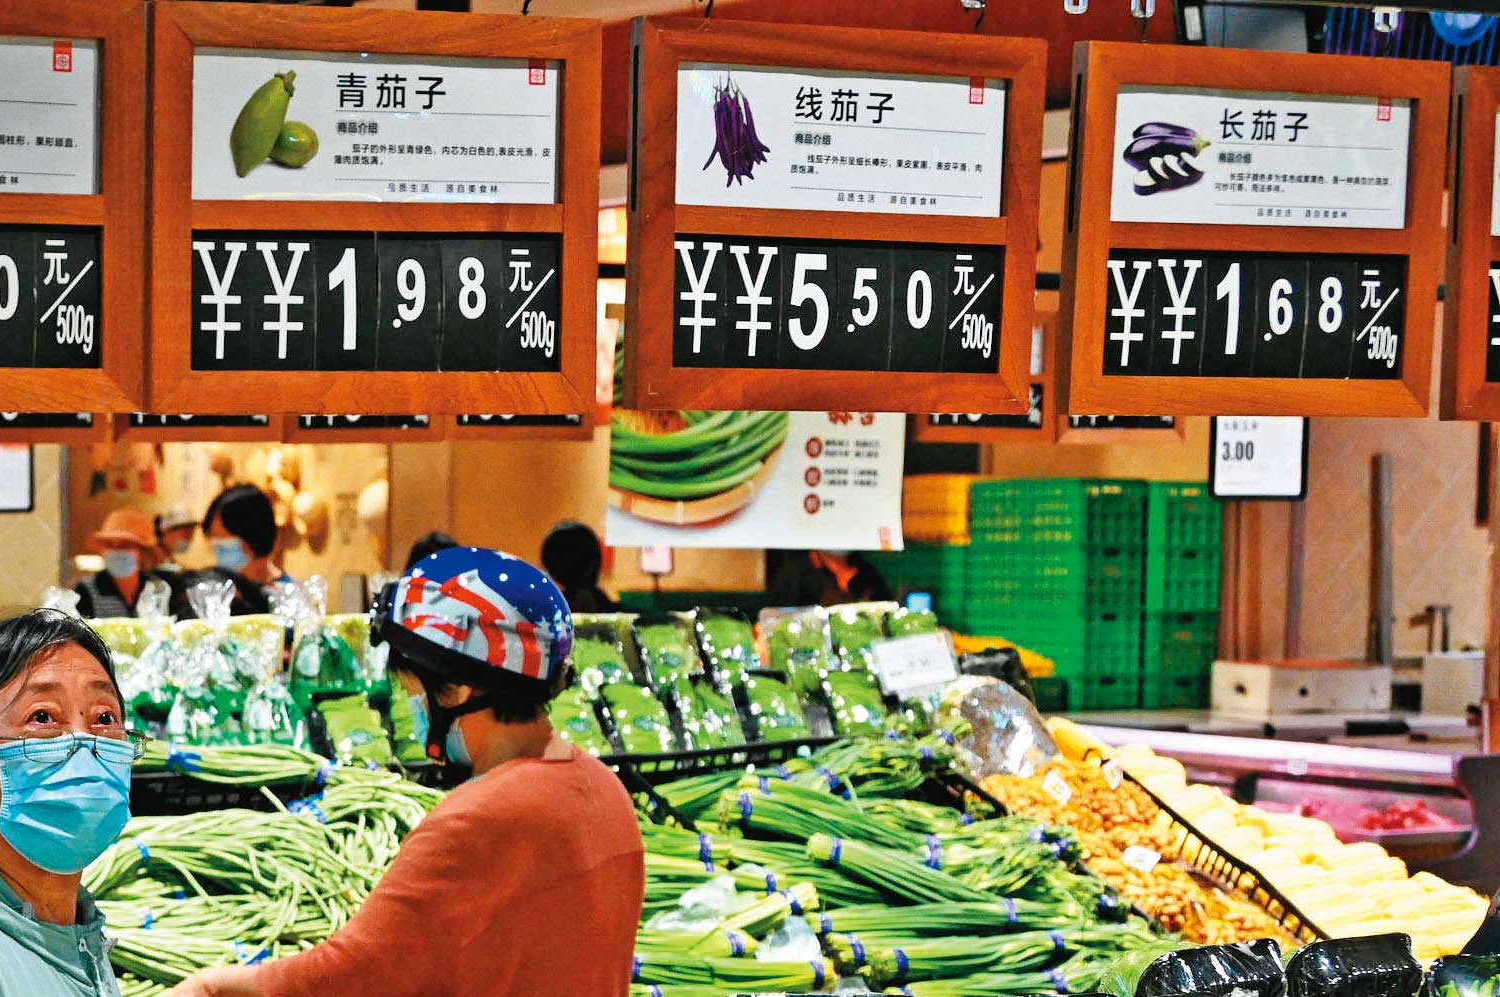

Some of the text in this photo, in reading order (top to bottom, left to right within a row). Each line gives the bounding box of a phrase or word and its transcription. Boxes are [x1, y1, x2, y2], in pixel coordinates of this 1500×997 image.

[336, 73, 446, 110] 青茄子
[795, 87, 895, 124] 线茄子
[337, 122, 378, 135] 商品介绍
[1220, 109, 1309, 142] 长茄子
[795, 133, 831, 145] 商品介绍
[1222, 441, 1254, 461] 3.00
